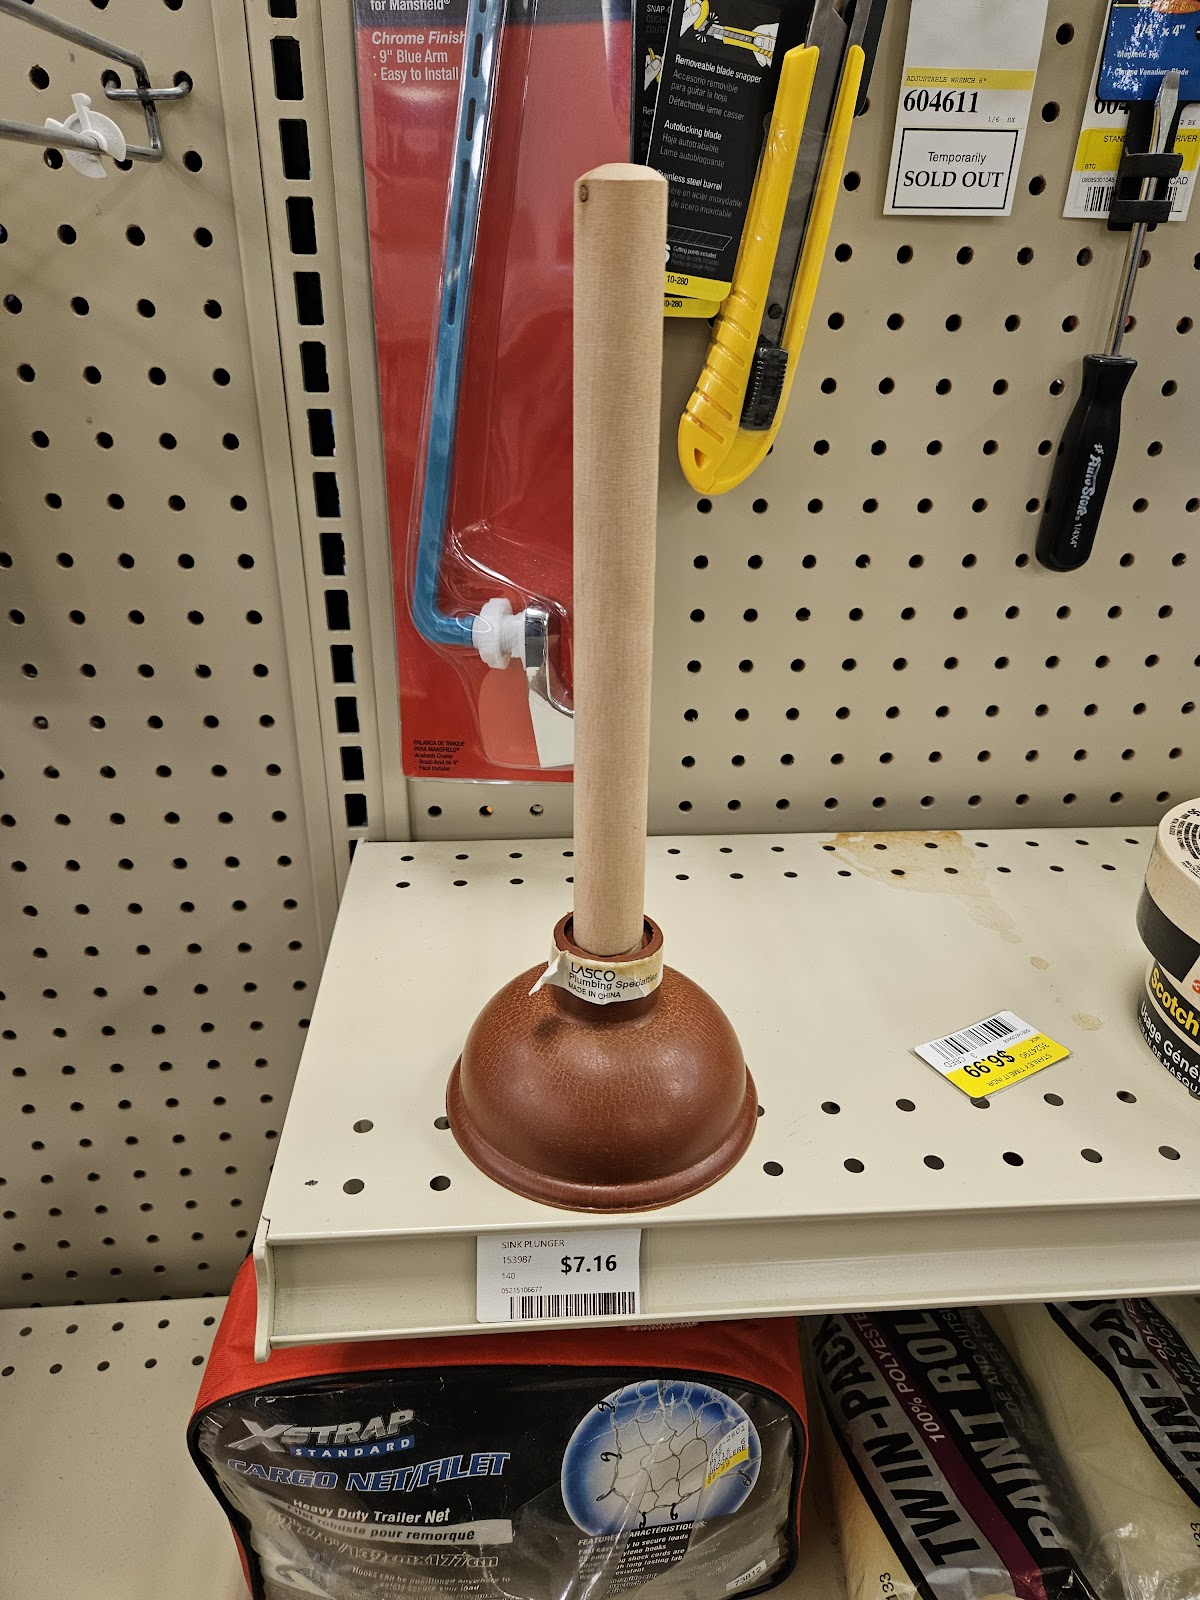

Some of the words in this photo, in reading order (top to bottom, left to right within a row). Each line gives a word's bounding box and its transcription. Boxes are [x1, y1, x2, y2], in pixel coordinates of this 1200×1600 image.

[370, 0, 387, 10] for
[372, 31, 424, 45] Chrome
[428, 30, 466, 44] Finish
[1172, 24, 1186, 37] 4"
[379, 50, 392, 64] 9"
[396, 49, 422, 64] Blue
[424, 49, 448, 63] Arm
[380, 67, 407, 84] Easy
[410, 68, 422, 80] to
[424, 66, 458, 81] Install
[672, 69, 706, 86] Accesorio
[675, 54, 716, 74] Removeable
[716, 62, 735, 78] blade
[735, 69, 762, 84] snapper
[1171, 68, 1189, 76] Blde
[906, 75, 948, 83] ADJUSTABLE
[670, 82, 687, 95] para
[706, 88, 714, 98] la
[714, 90, 728, 103] hoja
[903, 89, 979, 114] 604611
[706, 104, 723, 116] lame
[723, 109, 745, 122] casser
[662, 132, 678, 146] Hoja
[664, 119, 703, 140] Autolocking
[703, 128, 722, 142] blade
[660, 146, 678, 158] Lame
[928, 152, 987, 166] Temporarily
[686, 176, 703, 188] steel
[703, 179, 723, 192] barrel
[903, 170, 957, 188] SOLD
[962, 171, 1005, 188] OUT
[670, 200, 679, 209] de
[667, 275, 688, 286] 10-280
[571, 962, 616, 982] LASCO
[569, 972, 612, 991] Plumbing
[568, 982, 587, 996] MADE
[588, 990, 596, 998] IN
[598, 991, 621, 1000] CHINA
[1152, 967, 1200, 1037] Scotch
[1140, 1001, 1162, 1044] Usage
[963, 1049, 1016, 1078] $6.99
[1026, 1054, 1053, 1070] STANLEY
[502, 1240, 522, 1250] SINK
[524, 1239, 565, 1248] PLUNGER
[502, 1255, 532, 1264] 153987
[560, 1254, 617, 1276] $7.16
[502, 1272, 516, 1280] 140
[972, 1354, 1004, 1386] AND
[908, 1396, 946, 1442] 100%
[225, 1408, 416, 1453] XSTRAP
[295, 1438, 412, 1457] STANDARD
[815, 1315, 982, 1567] TWIN-PACK
[227, 1458, 339, 1491] CARGO
[345, 1452, 511, 1493] NET/FILET
[950, 1408, 1064, 1550] PAINT
[293, 1499, 334, 1518] Heavy
[337, 1507, 370, 1524] Duty
[374, 1510, 422, 1524] Trailer
[424, 1507, 451, 1524] Net
[316, 1516, 366, 1536] robuste
[370, 1528, 403, 1544] pour
[406, 1529, 475, 1544] remorque
[642, 1537, 666, 1546] secure
[668, 1534, 689, 1542] loads
[644, 1544, 667, 1554] hooks
[628, 1554, 649, 1563] shock
[651, 1550, 671, 1559] cords
